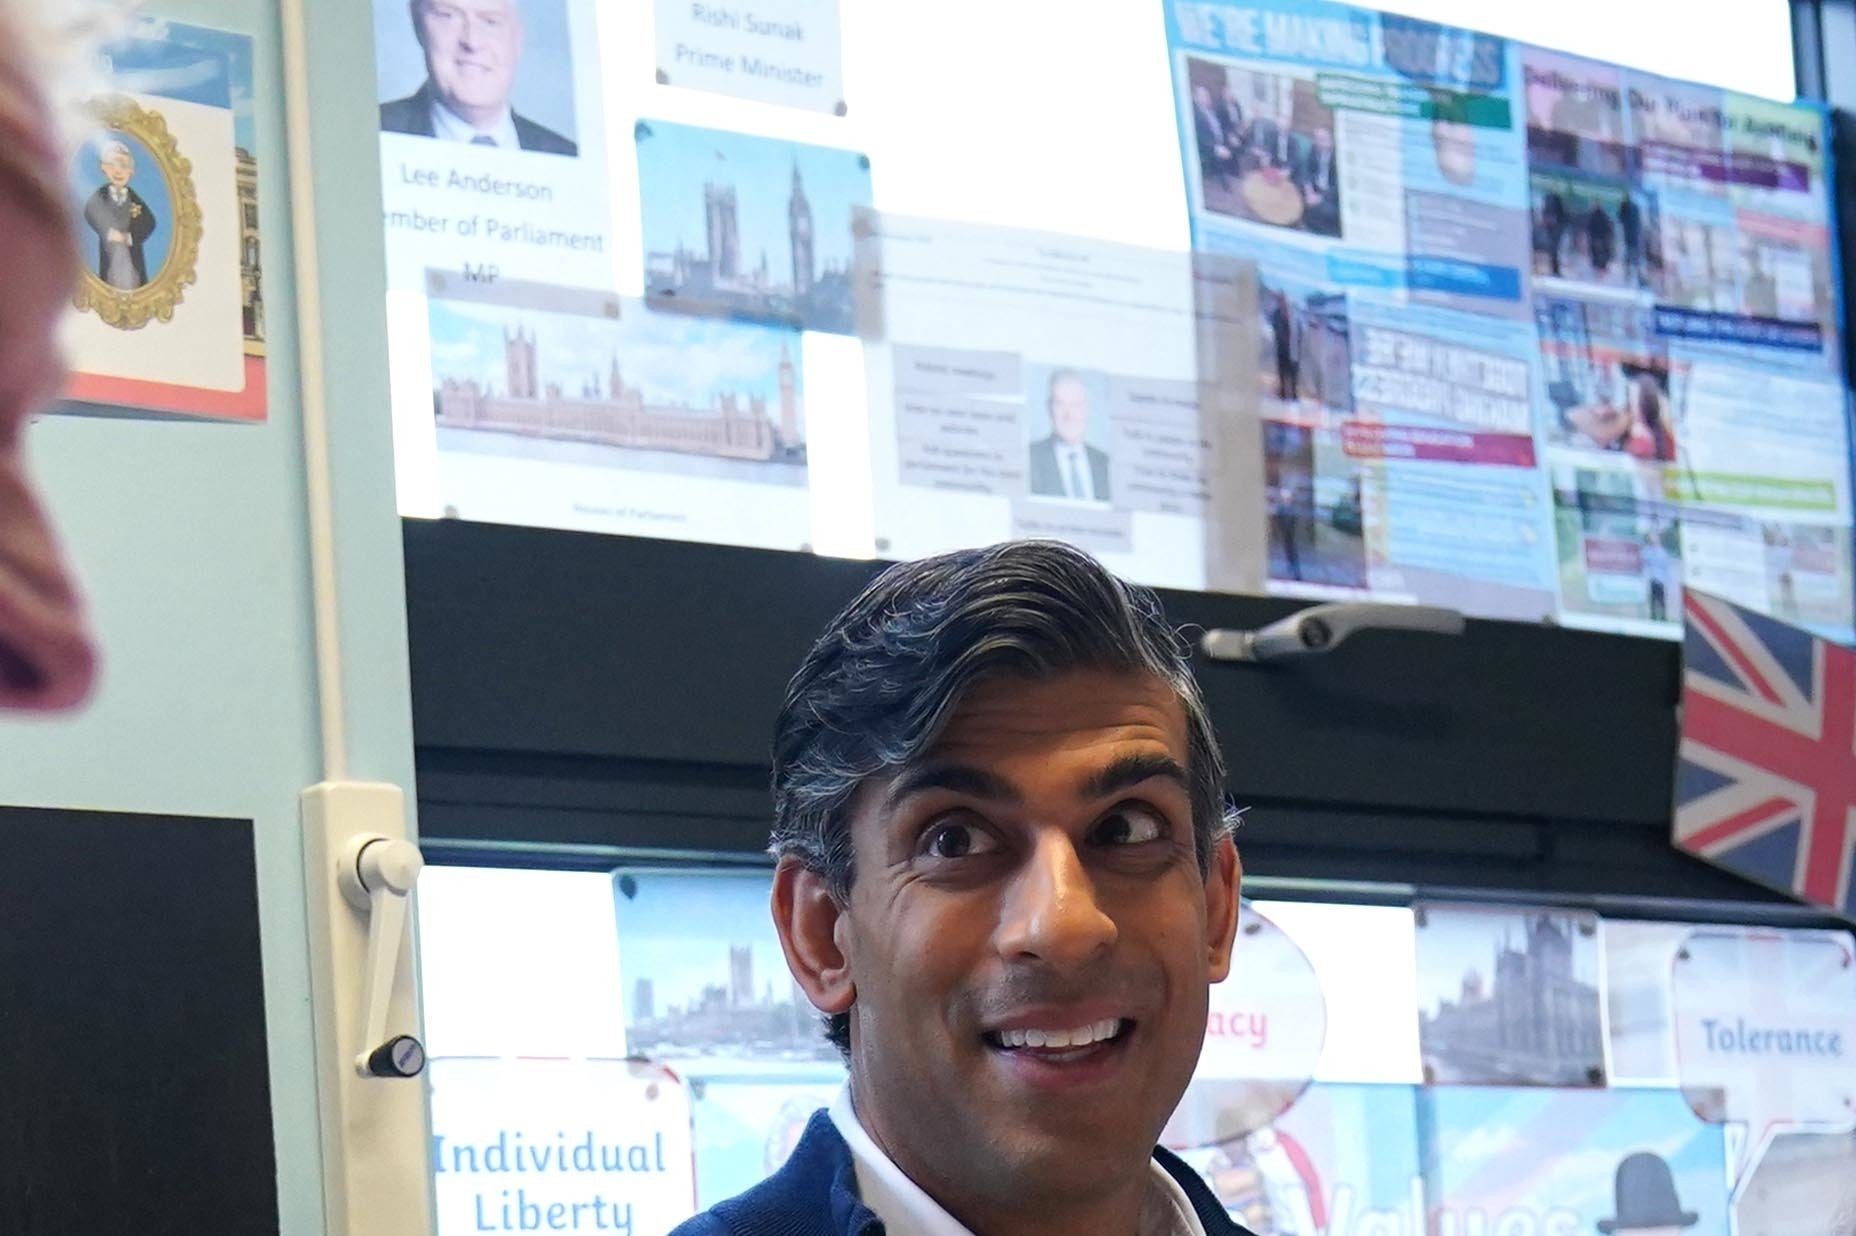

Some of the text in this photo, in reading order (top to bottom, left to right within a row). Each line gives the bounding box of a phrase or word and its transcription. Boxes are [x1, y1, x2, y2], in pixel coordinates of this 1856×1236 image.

[693, 3, 803, 40] Rishi Sunak
[675, 43, 823, 87] Prime Minister
[401, 163, 553, 200] Lee Anderson
[384, 209, 603, 252] mber of Parliament
[463, 261, 499, 283] MP
[1208, 1012, 1267, 1048] acy
[1702, 1019, 1842, 1057] Tolerance
[434, 1131, 665, 1175] Individual
